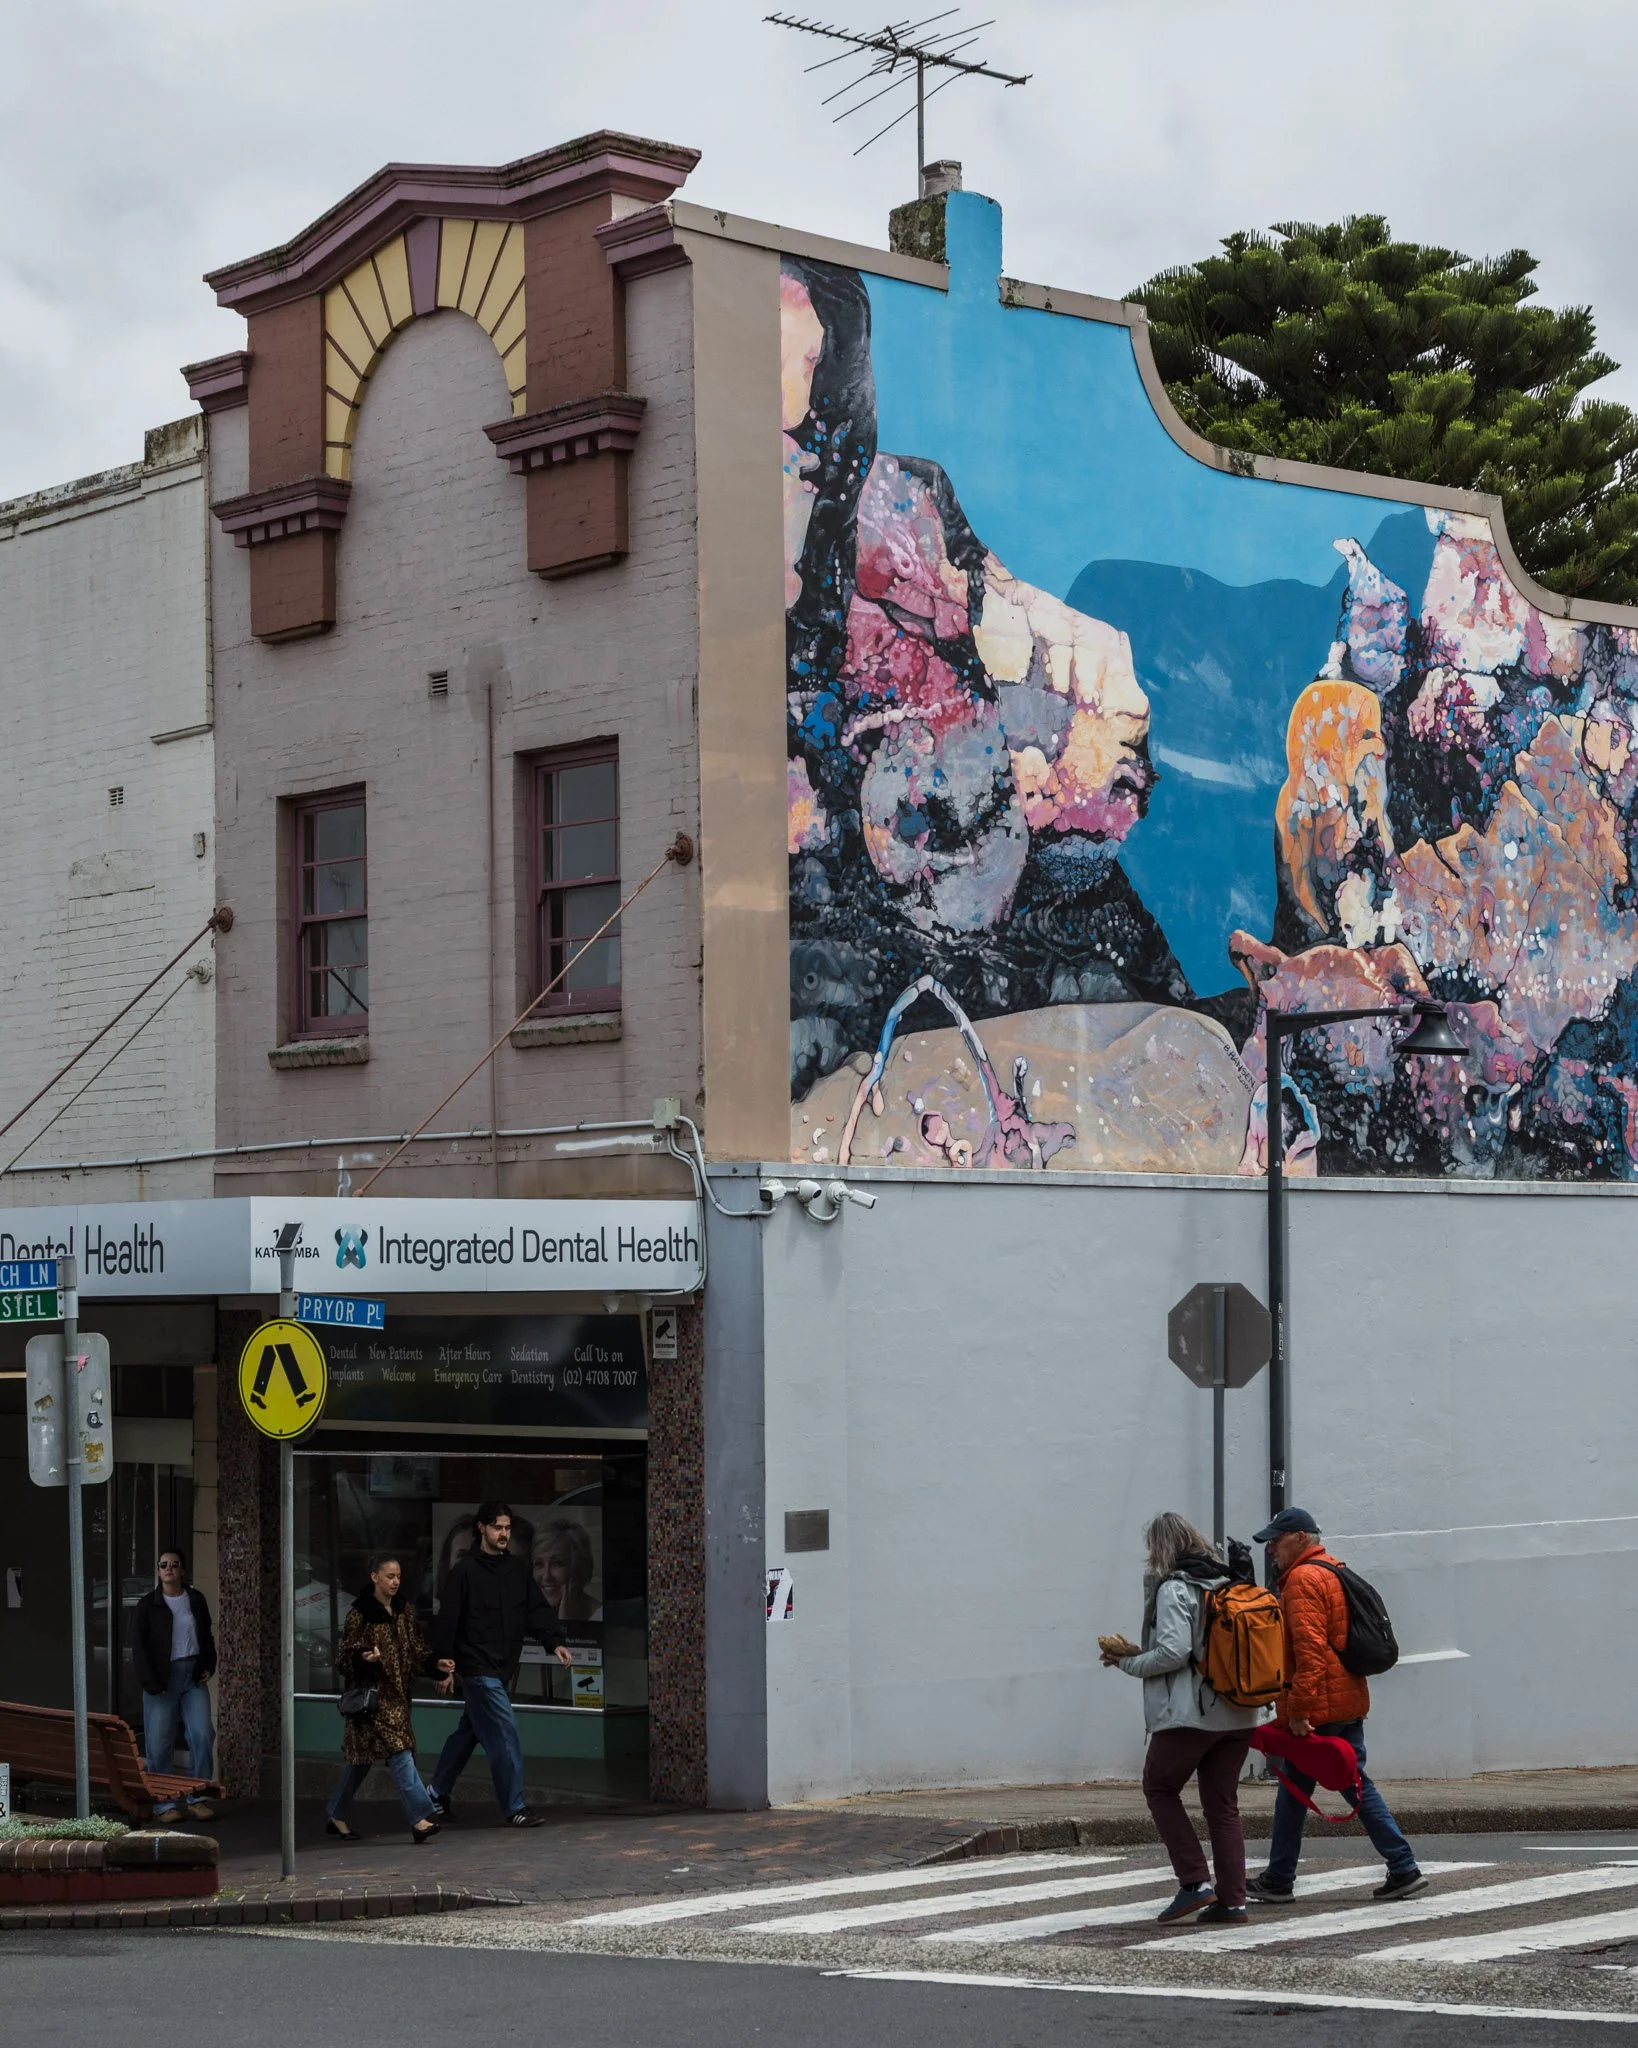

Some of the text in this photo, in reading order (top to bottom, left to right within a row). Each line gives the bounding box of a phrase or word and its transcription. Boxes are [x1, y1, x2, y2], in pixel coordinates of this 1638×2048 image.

[85, 1222, 164, 1275] Health
[255, 1247, 320, 1259] KATMBA
[379, 1226, 699, 1272] Integrated Dental Health
[30, 1263, 49, 1285] LN
[2, 1294, 47, 1318] STEL
[303, 1297, 382, 1324] PRYOR PL
[329, 1343, 358, 1359] Dental
[368, 1343, 423, 1360] New Patients
[439, 1343, 491, 1367] After Hours
[510, 1343, 549, 1362] Sedation
[574, 1344, 624, 1363] Call Us on
[328, 1364, 364, 1387] Implants
[382, 1365, 416, 1382] Welcome
[433, 1368, 503, 1389] Emergency Care
[511, 1369, 554, 1391] Dentistry
[563, 1366, 638, 1387] (02) 4708 7007
